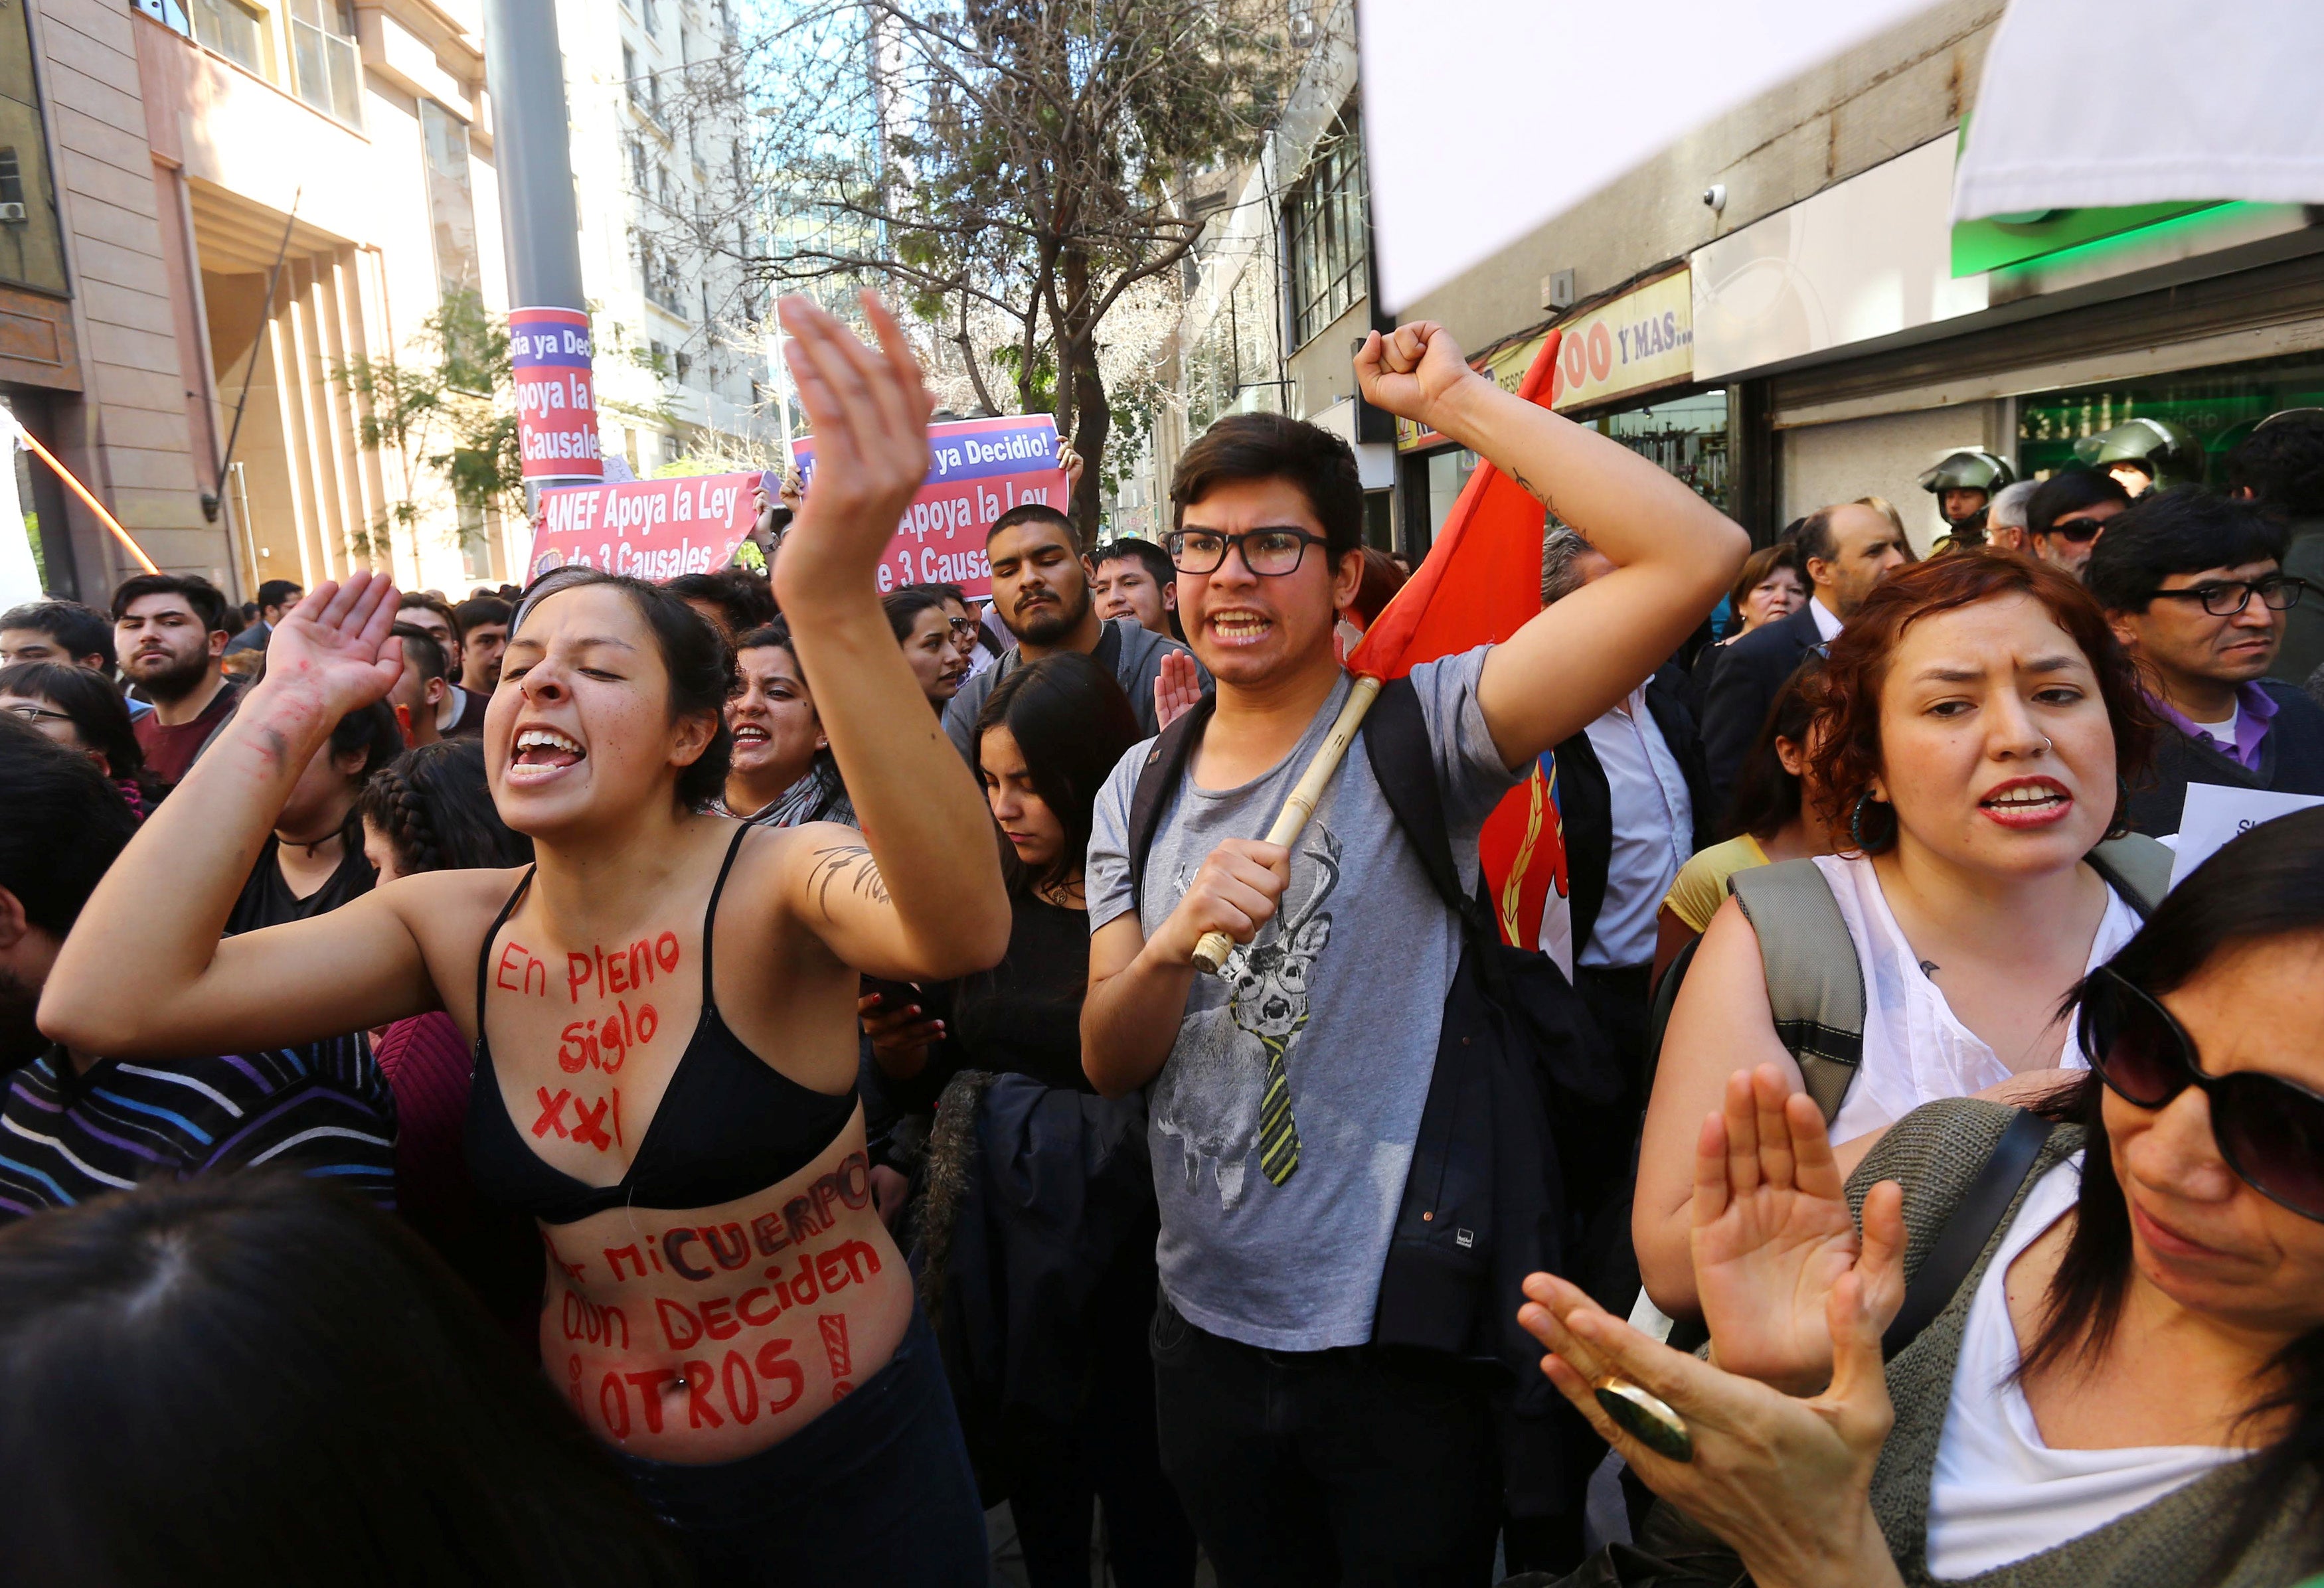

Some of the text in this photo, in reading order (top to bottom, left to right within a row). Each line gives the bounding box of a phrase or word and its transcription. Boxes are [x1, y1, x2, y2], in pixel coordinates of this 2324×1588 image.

[533, 335, 558, 360] ya
[562, 329, 592, 358] Dec
[1618, 328, 1628, 364] Y
[515, 377, 565, 420] poya
[570, 373, 588, 410] la
[523, 424, 601, 461] Causale
[934, 432, 1050, 475] ya Decidio!
[546, 481, 738, 537] ANEF Apoya la Ley
[898, 497, 972, 543] Apoya
[977, 485, 1000, 523] la
[599, 543, 611, 575] 3
[617, 537, 712, 580] Causales
[875, 546, 992, 593] e 3 Causa
[498, 941, 545, 997] En
[531, 1086, 623, 1151] XXI
[662, 1151, 870, 1283] CUERPO
